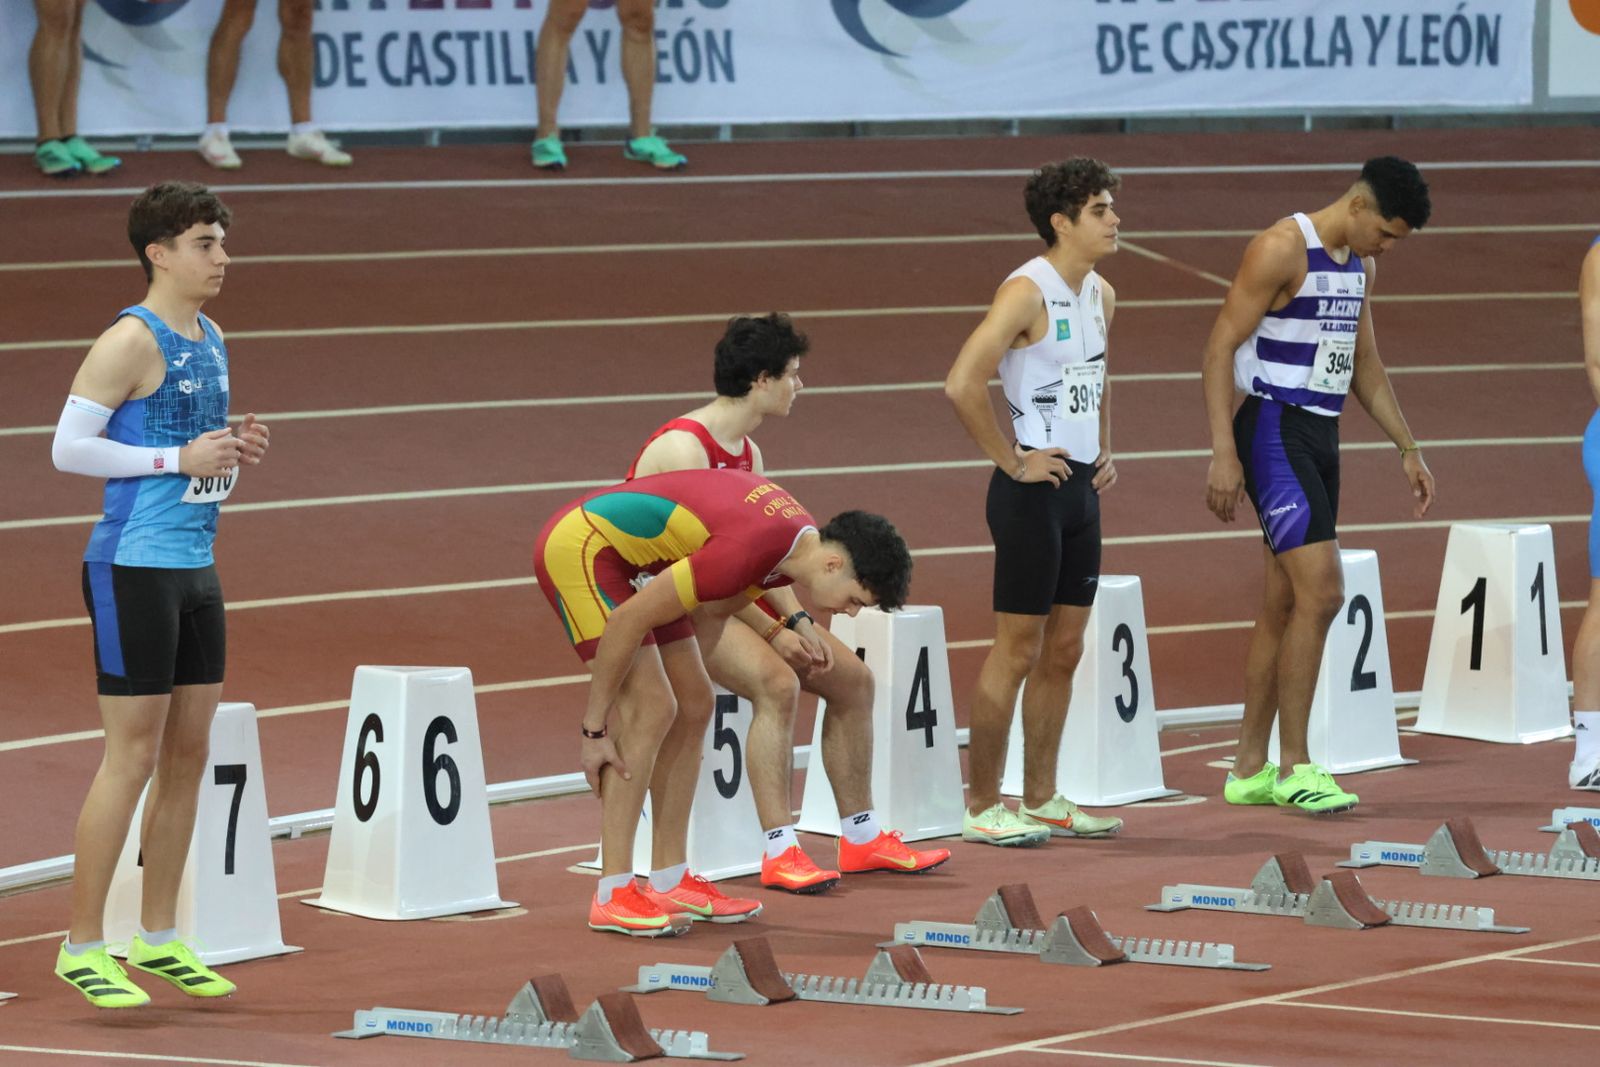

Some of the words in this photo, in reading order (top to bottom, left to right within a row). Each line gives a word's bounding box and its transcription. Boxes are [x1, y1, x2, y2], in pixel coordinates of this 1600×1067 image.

[312, 32, 367, 88] DE
[584, 29, 611, 85] Y
[655, 17, 735, 84] EÓN
[1096, 23, 1153, 75] DE
[1162, 15, 1354, 73] CASTILLA
[1361, 14, 1391, 67] Y
[1396, 2, 1502, 67] LEÓN
[1347, 594, 1377, 692] 2
[1461, 577, 1487, 671] 1
[1531, 561, 1548, 656] 1
[906, 646, 938, 748] 4
[1112, 622, 1139, 723] 3
[352, 712, 384, 823] 6
[422, 715, 461, 826] 6
[713, 694, 742, 799] 5
[214, 764, 247, 875] 7
[1192, 895, 1236, 907] MONDO
[386, 1019, 433, 1033] MONDO
